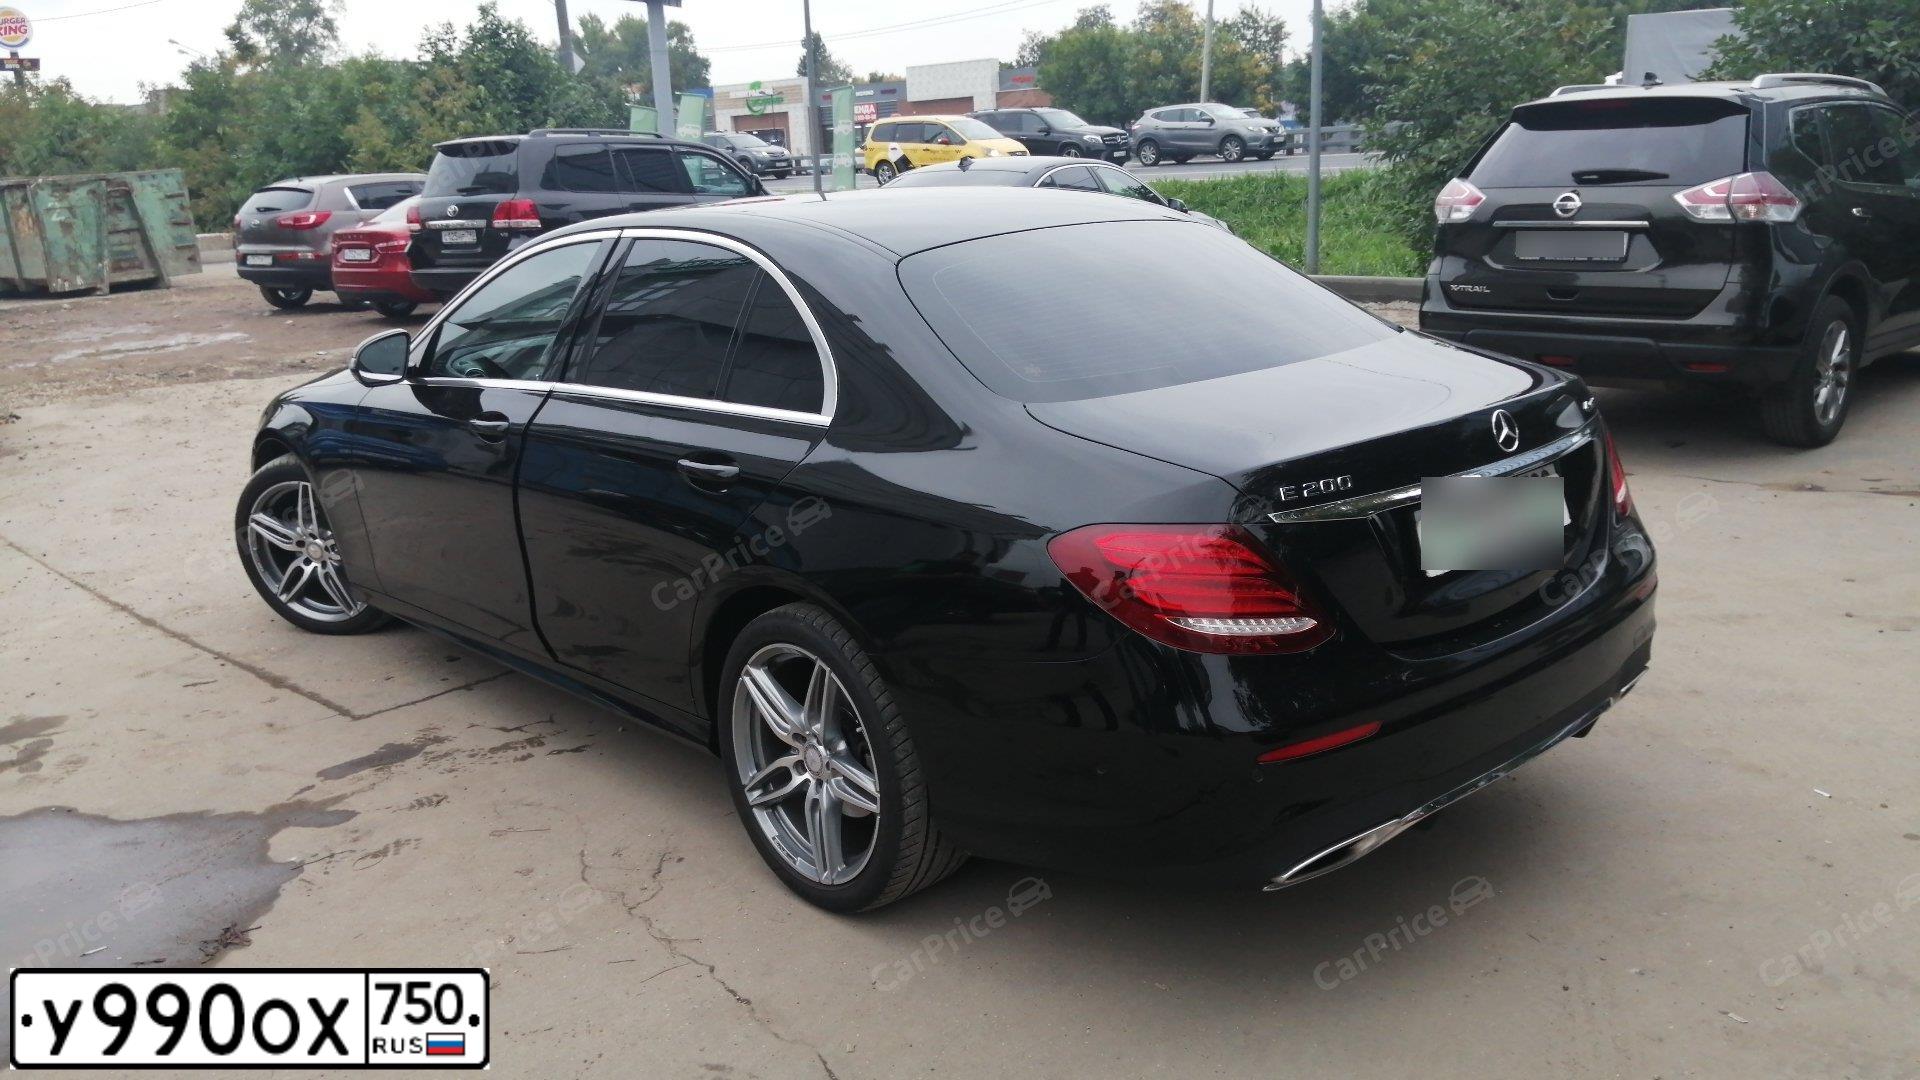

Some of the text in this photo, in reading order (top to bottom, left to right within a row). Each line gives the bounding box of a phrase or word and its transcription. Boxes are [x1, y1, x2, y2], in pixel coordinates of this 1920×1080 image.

[0, 17, 26, 25] URGER
[854, 104, 876, 114] ЕНДА
[1279, 474, 1353, 501] E 200
